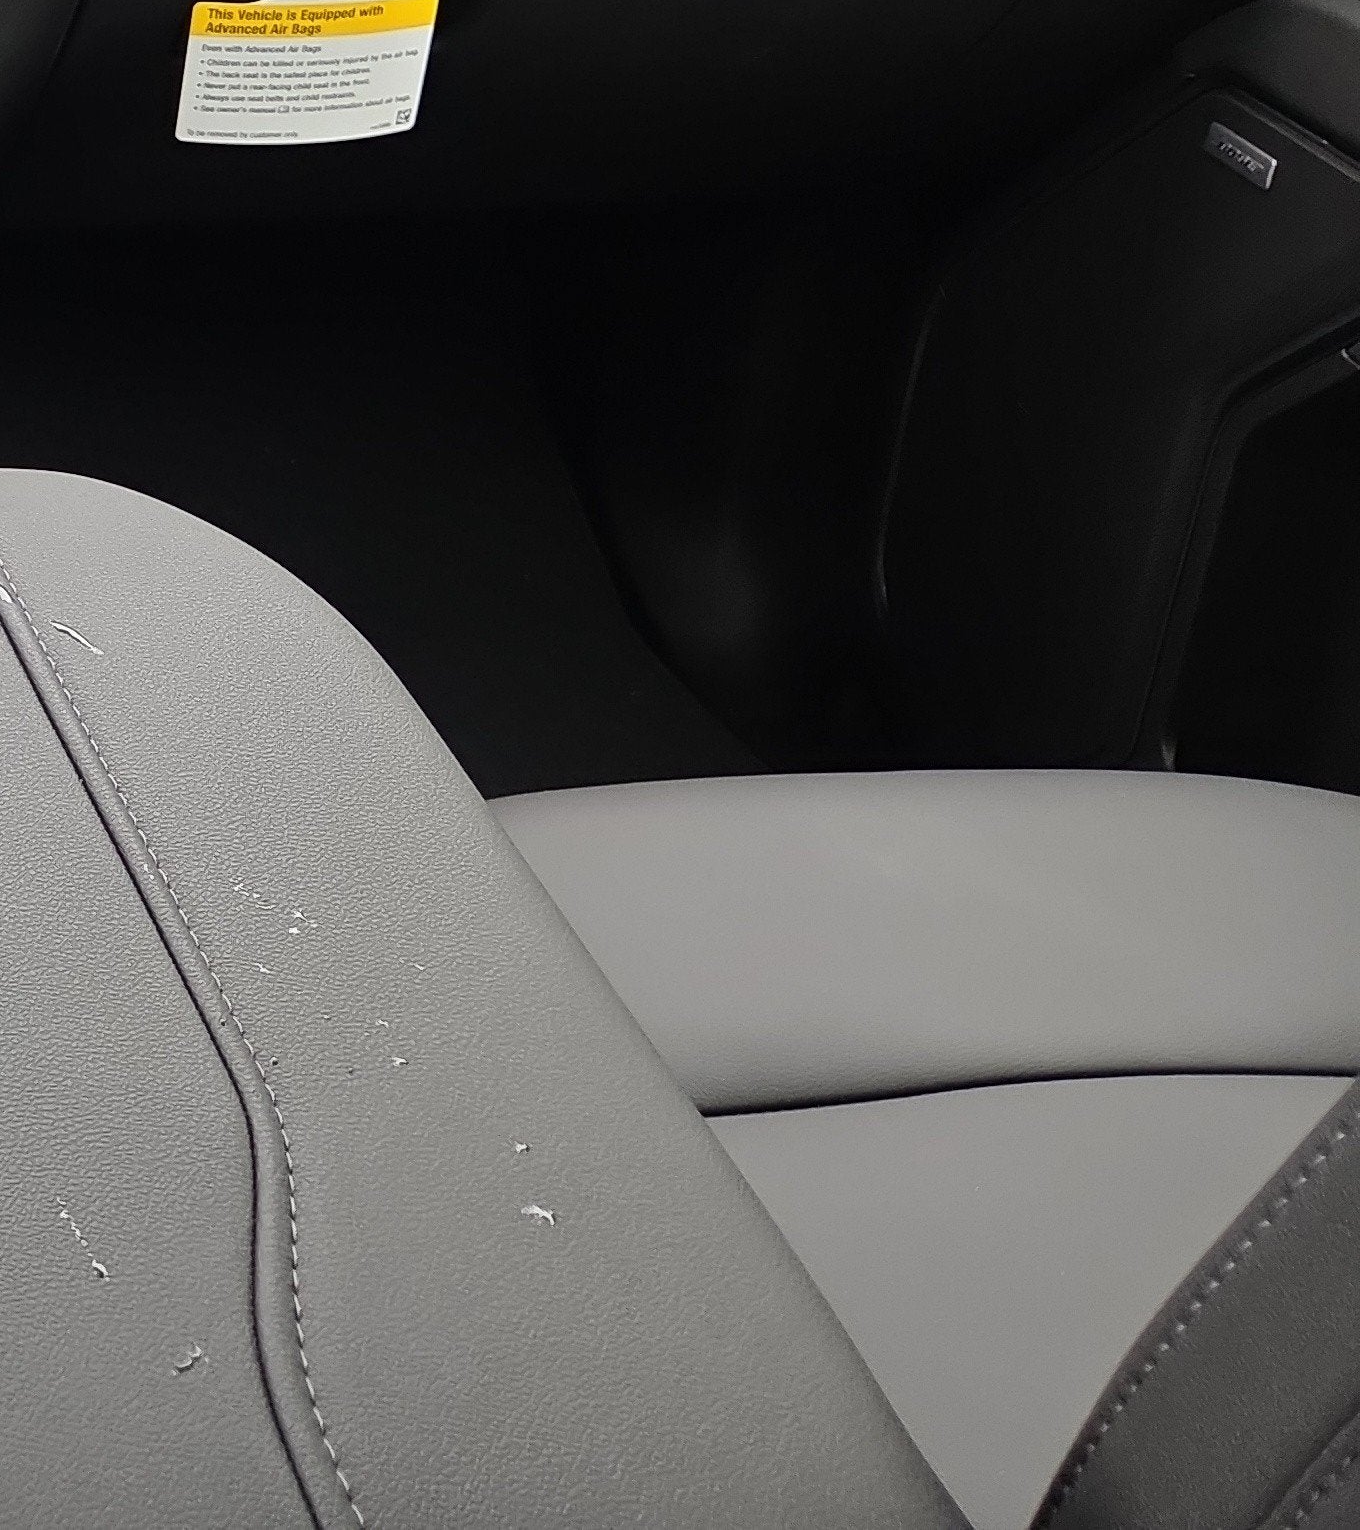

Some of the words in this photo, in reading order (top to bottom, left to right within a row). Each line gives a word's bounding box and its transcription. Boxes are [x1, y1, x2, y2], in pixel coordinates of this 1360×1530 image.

[208, 8, 234, 20] This
[237, 9, 283, 21] Vehicle
[286, 10, 296, 20] is
[301, 7, 356, 21] Equipped
[359, 5, 384, 16] with
[205, 22, 266, 34] Advanced
[270, 23, 287, 34] Air
[292, 23, 321, 36] Bags
